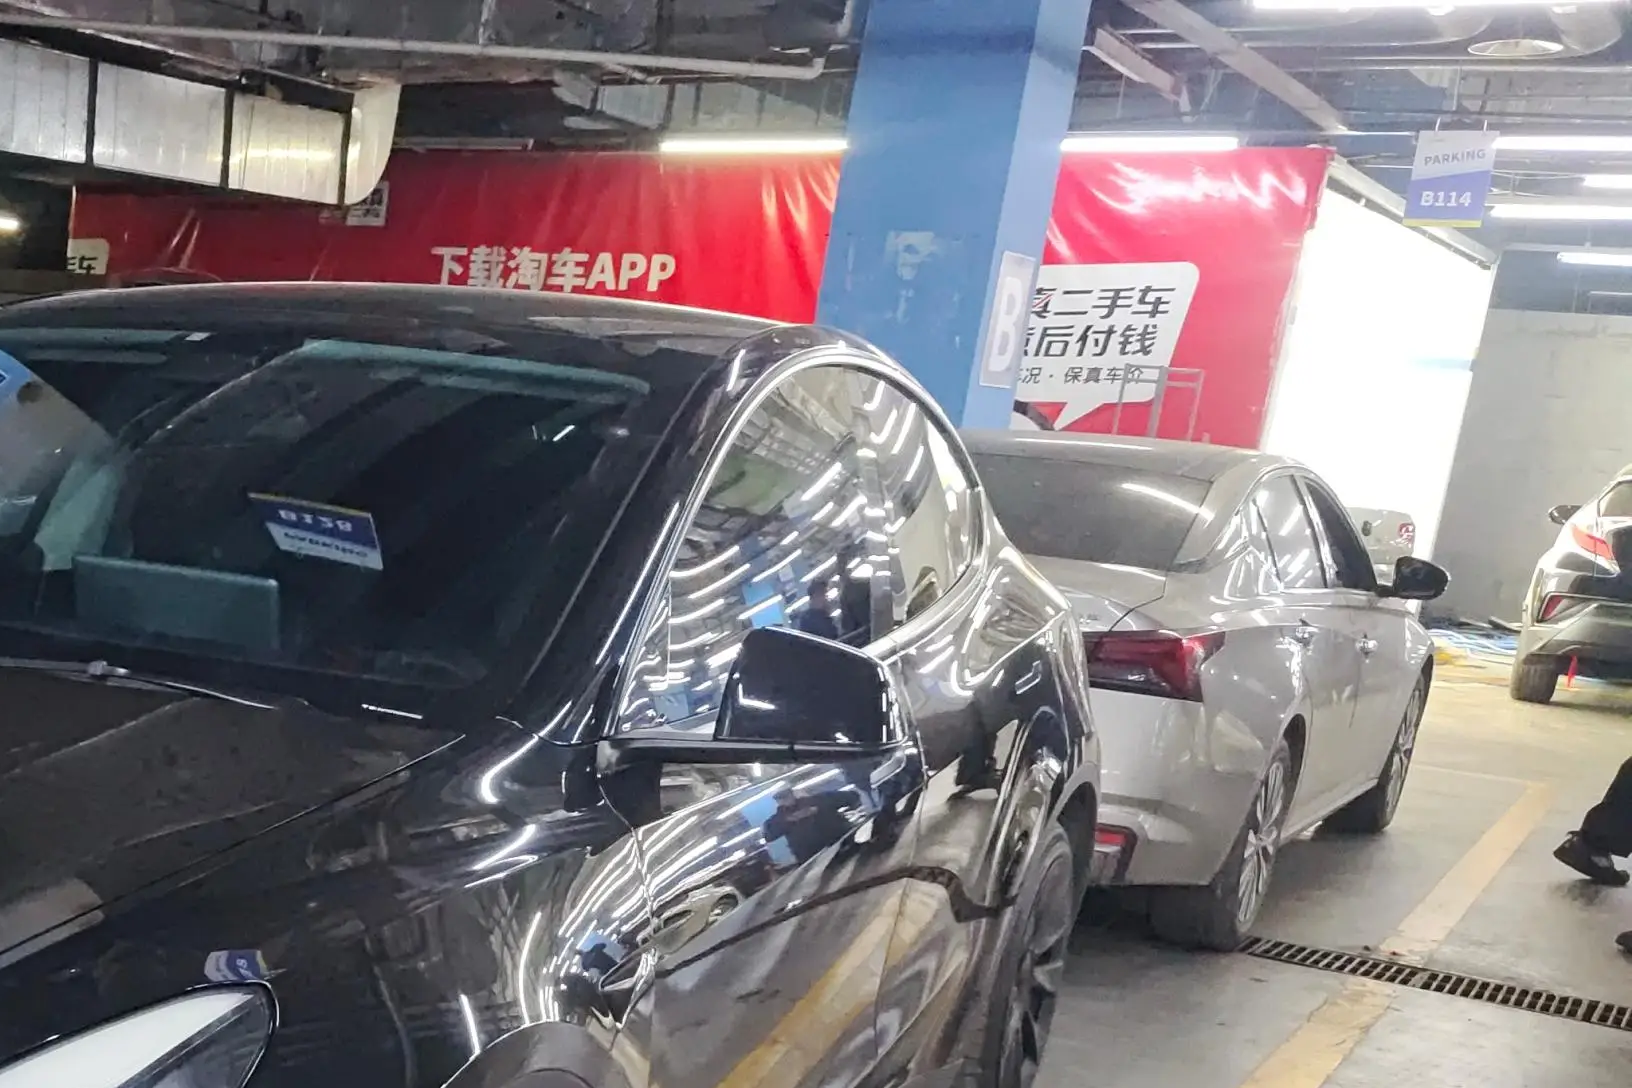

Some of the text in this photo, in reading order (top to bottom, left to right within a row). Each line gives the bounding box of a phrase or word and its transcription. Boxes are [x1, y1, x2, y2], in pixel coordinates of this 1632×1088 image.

[1424, 148, 1487, 166] PARKING
[1420, 191, 1472, 207] B114
[431, 245, 677, 292] 下载淘车APP
[988, 276, 1024, 372] B
